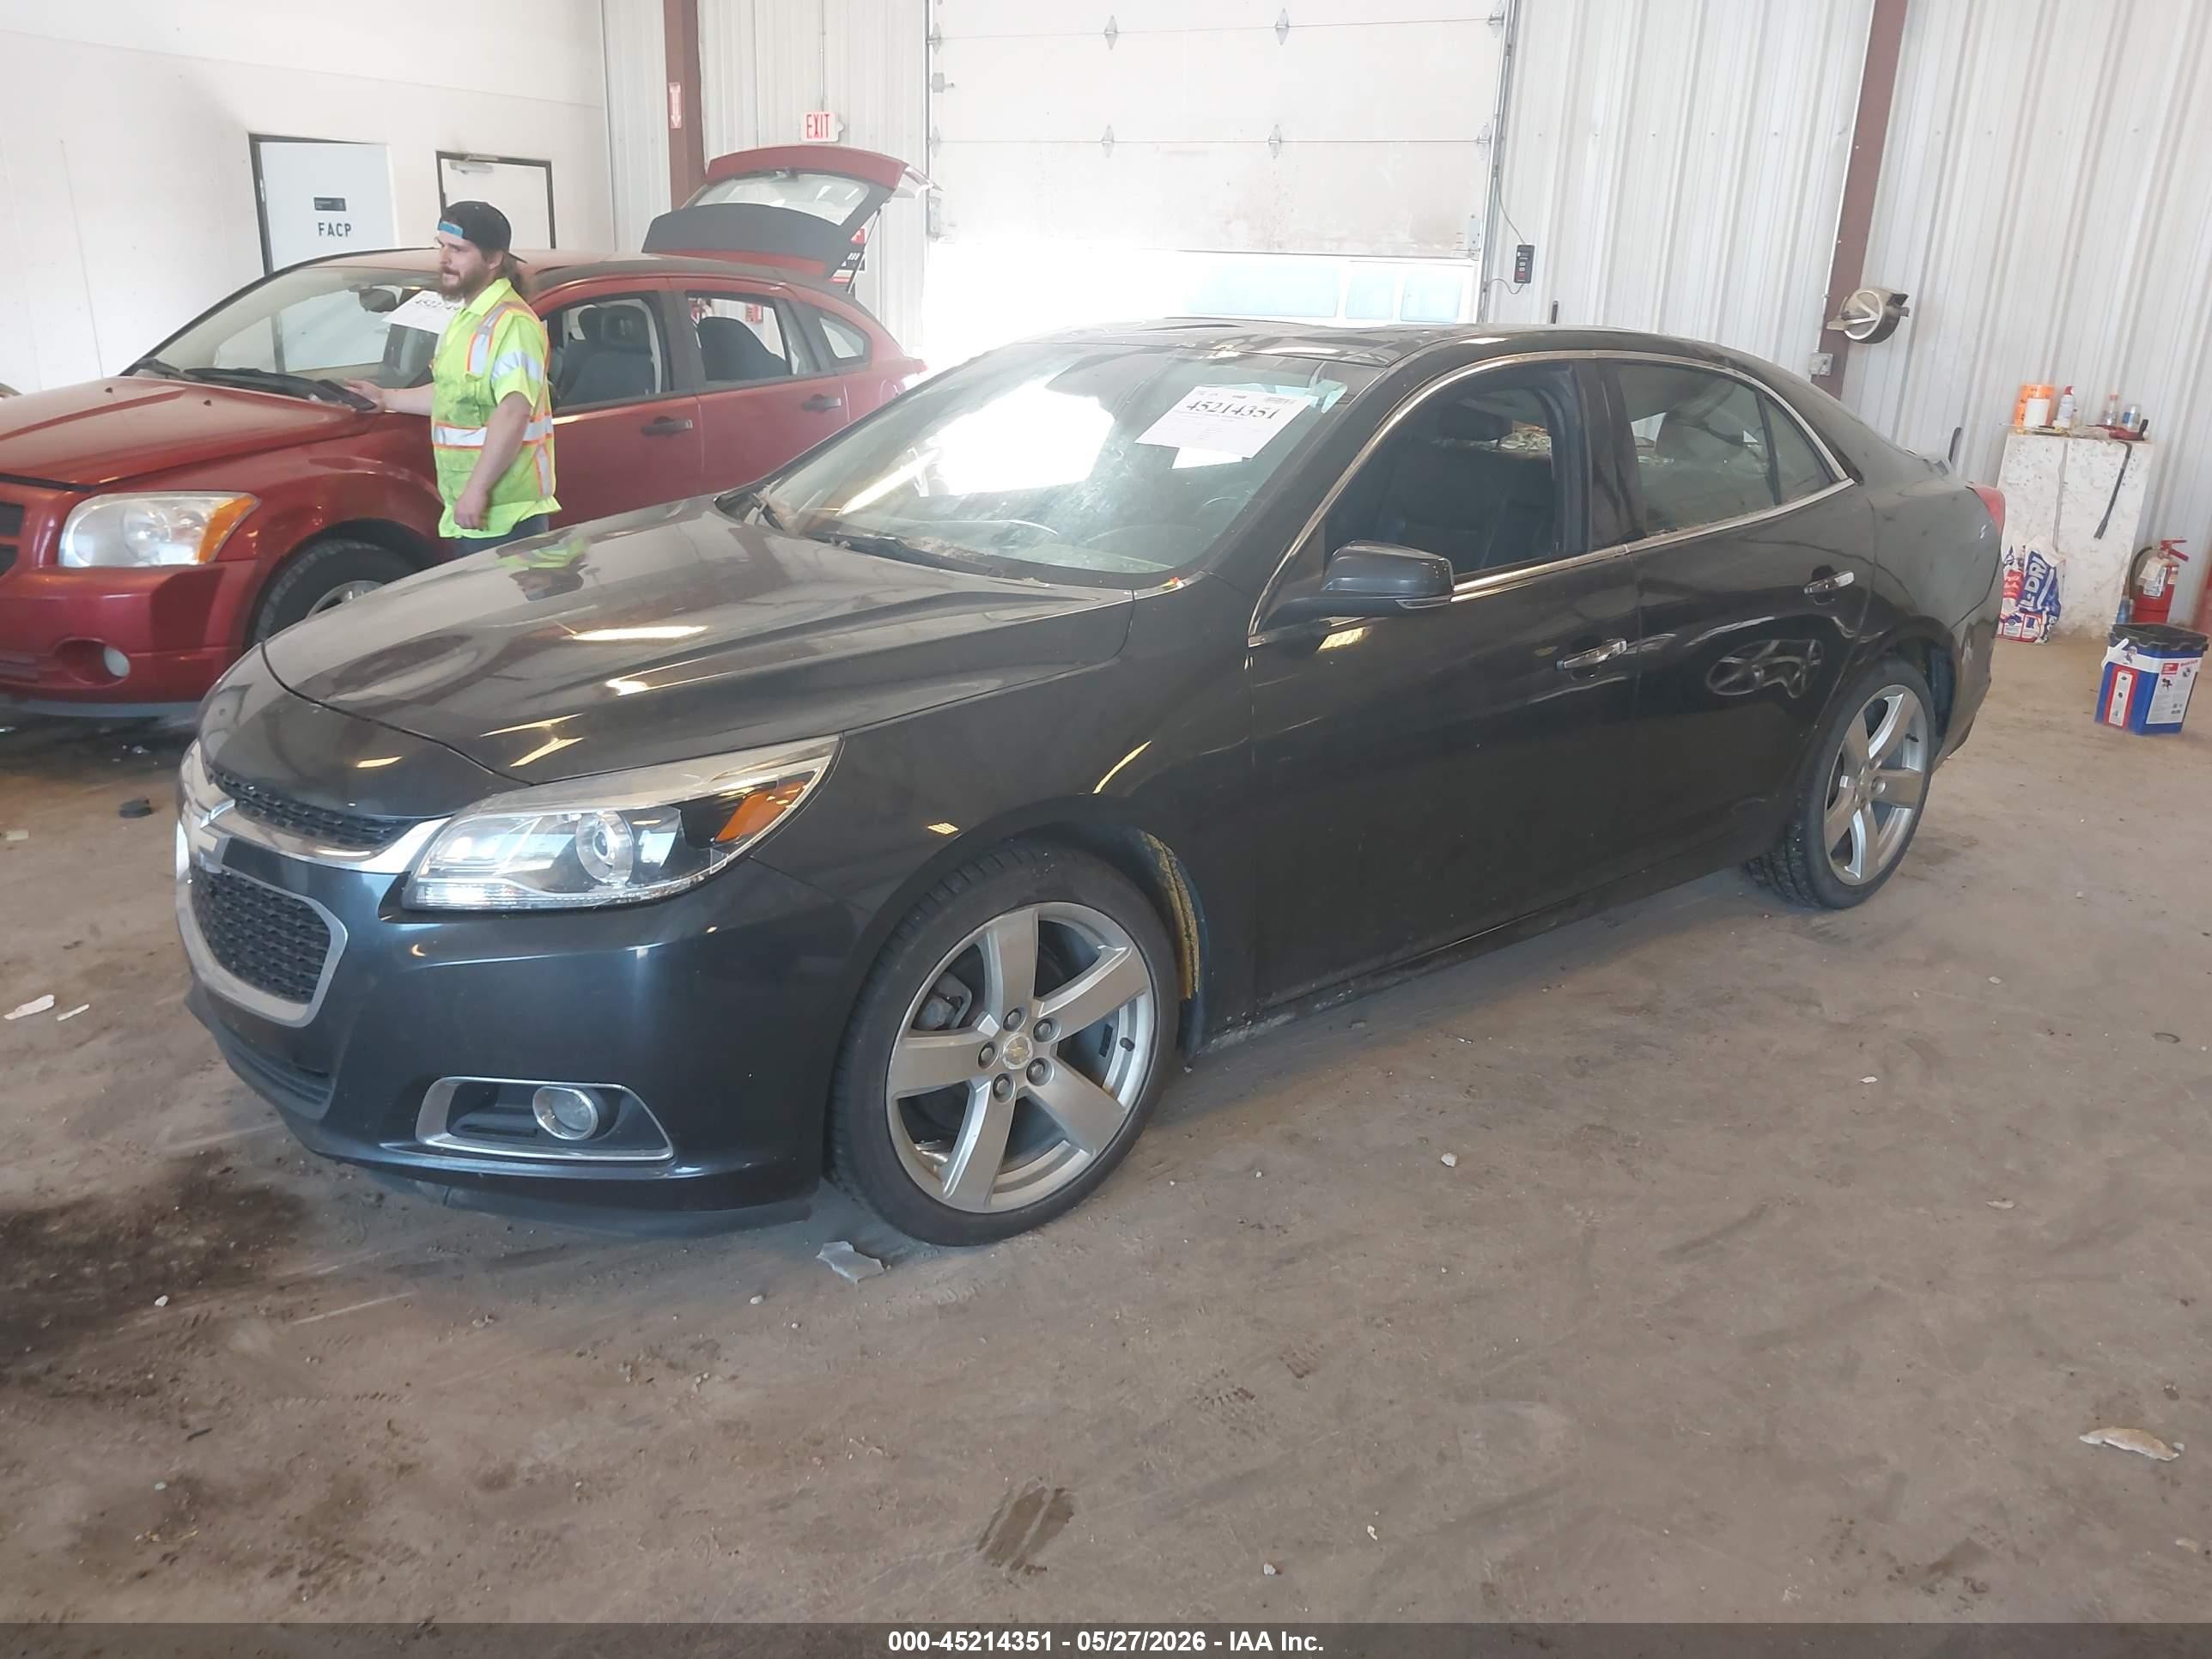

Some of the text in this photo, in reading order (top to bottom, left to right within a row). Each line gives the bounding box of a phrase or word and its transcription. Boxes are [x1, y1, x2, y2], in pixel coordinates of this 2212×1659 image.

[806, 113, 830, 138] EXIT
[318, 222, 351, 237] FACP
[1187, 400, 1279, 419] 45214351
